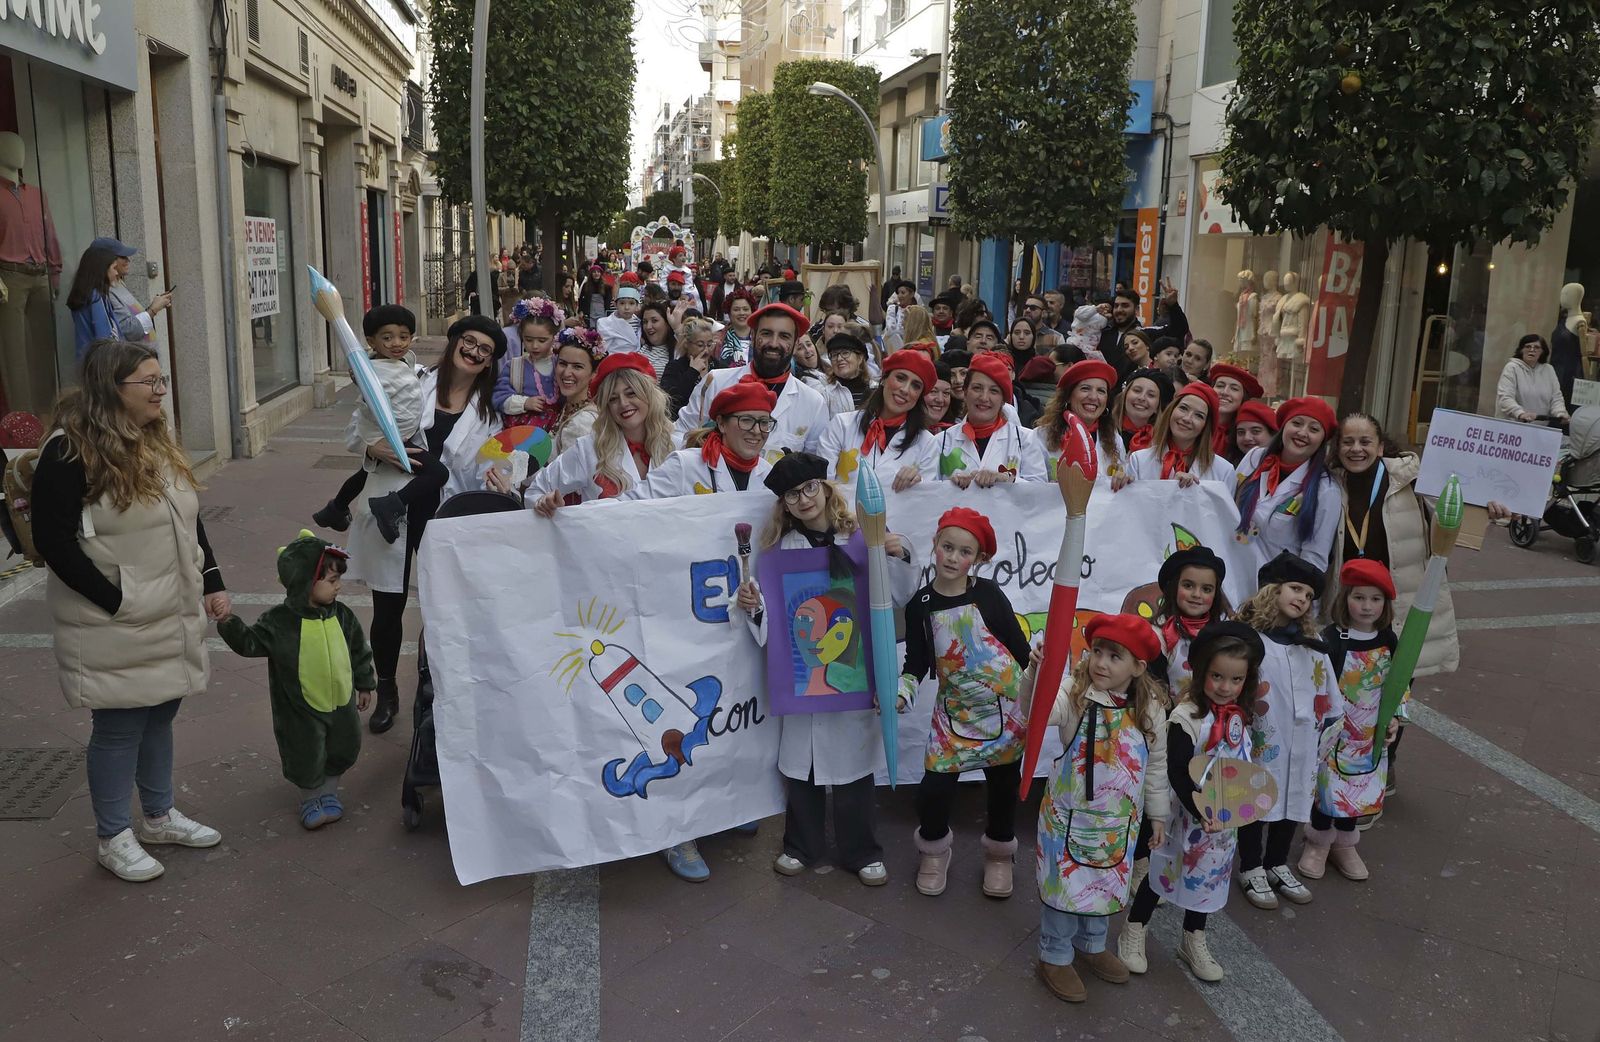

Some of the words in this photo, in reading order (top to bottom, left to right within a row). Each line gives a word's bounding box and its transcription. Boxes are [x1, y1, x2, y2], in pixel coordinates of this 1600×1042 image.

[254, 221, 275, 243] VENDE
[1466, 427, 1482, 440] CEI
[1483, 430, 1494, 442] EL
[1497, 432, 1522, 447] FARO
[1431, 435, 1456, 449] CEPR
[1457, 440, 1475, 453] LOS
[1476, 444, 1552, 468] ALCORNOCALES
[708, 696, 766, 737] con
